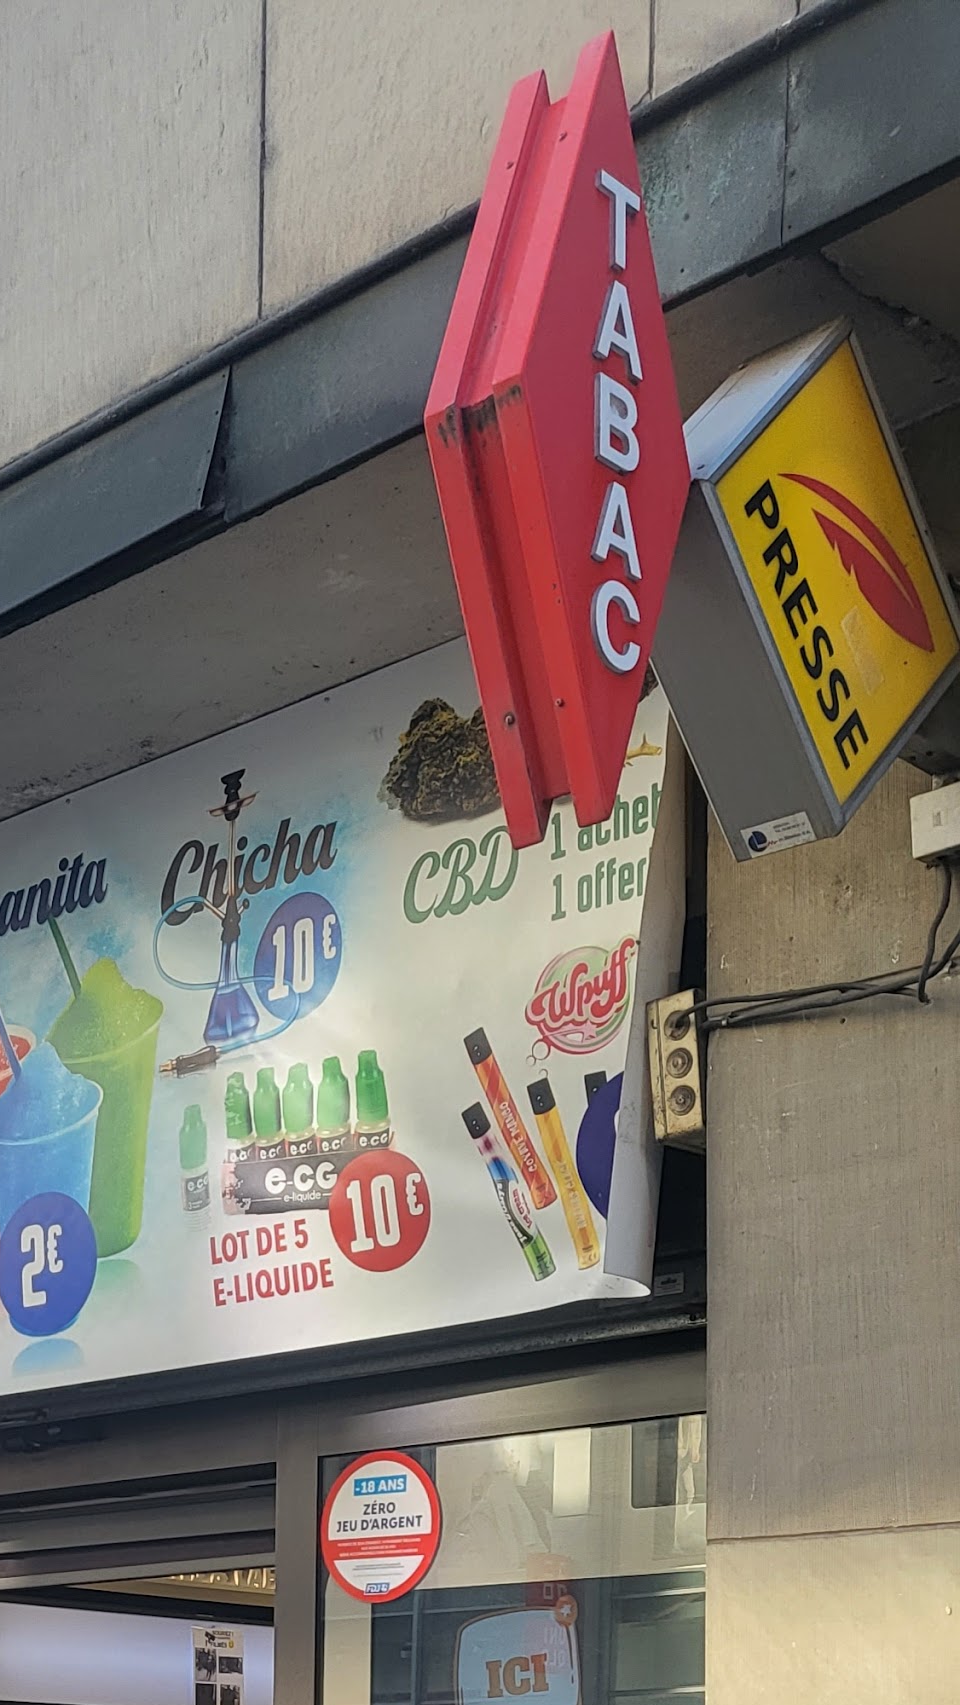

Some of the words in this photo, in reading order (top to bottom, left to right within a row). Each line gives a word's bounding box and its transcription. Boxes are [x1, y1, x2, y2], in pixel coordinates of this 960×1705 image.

[592, 168, 642, 674] TABAC
[744, 479, 870, 771] PRESSE
[550, 812, 567, 861] 1
[160, 817, 339, 927] Chicha
[402, 827, 520, 925] CBD
[551, 873, 567, 922] 1
[577, 855, 651, 914] offer
[19, 1223, 64, 1309] 2€
[209, 1229, 250, 1265] LOT
[255, 1221, 288, 1257] DE
[294, 1218, 309, 1249] 5
[213, 1257, 335, 1307] E-LIQUIDE
[355, 1480, 376, 1493] -18
[378, 1478, 405, 1492] ANS
[363, 1500, 396, 1515] ZÉRO
[336, 1519, 358, 1533] JEU
[360, 1515, 423, 1531] D'ARGENT
[485, 1652, 550, 1699] ICI
